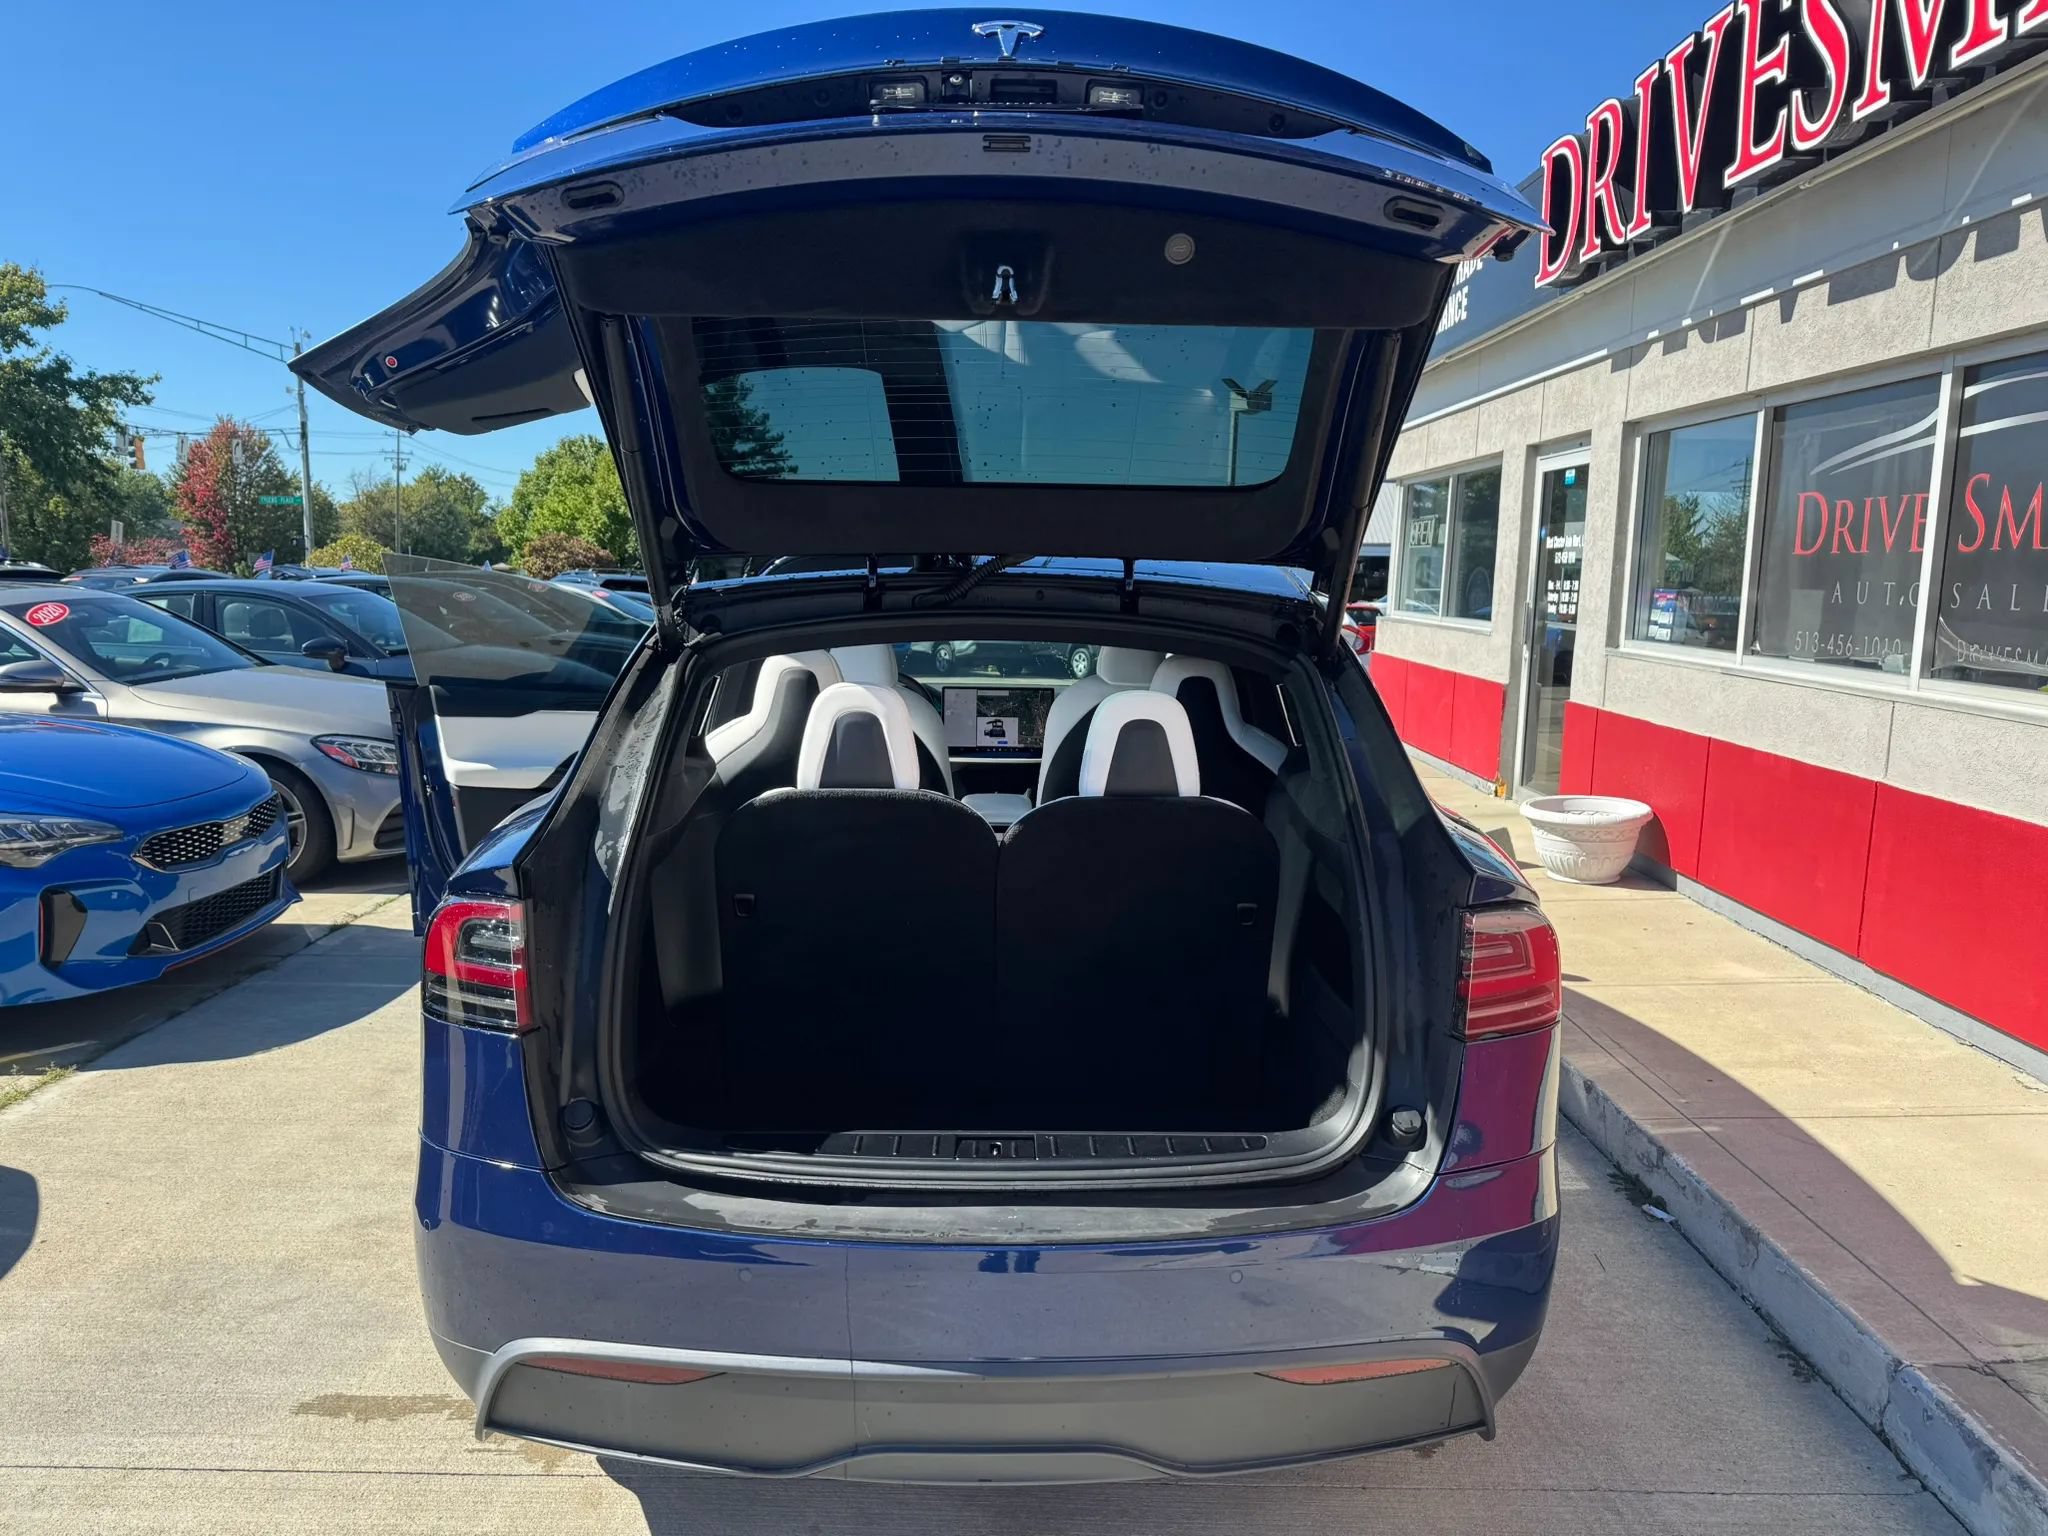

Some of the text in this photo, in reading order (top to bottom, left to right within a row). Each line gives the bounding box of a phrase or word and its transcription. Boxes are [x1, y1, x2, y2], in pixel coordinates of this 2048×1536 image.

[1534, 0, 2048, 289] DRIVESM
[1436, 285, 1469, 335] ANCE
[1410, 520, 1434, 546] OPEN
[1792, 490, 1930, 556] DRIVE
[1831, 580, 1921, 607] AUTO
[32, 604, 65, 624] 2020
